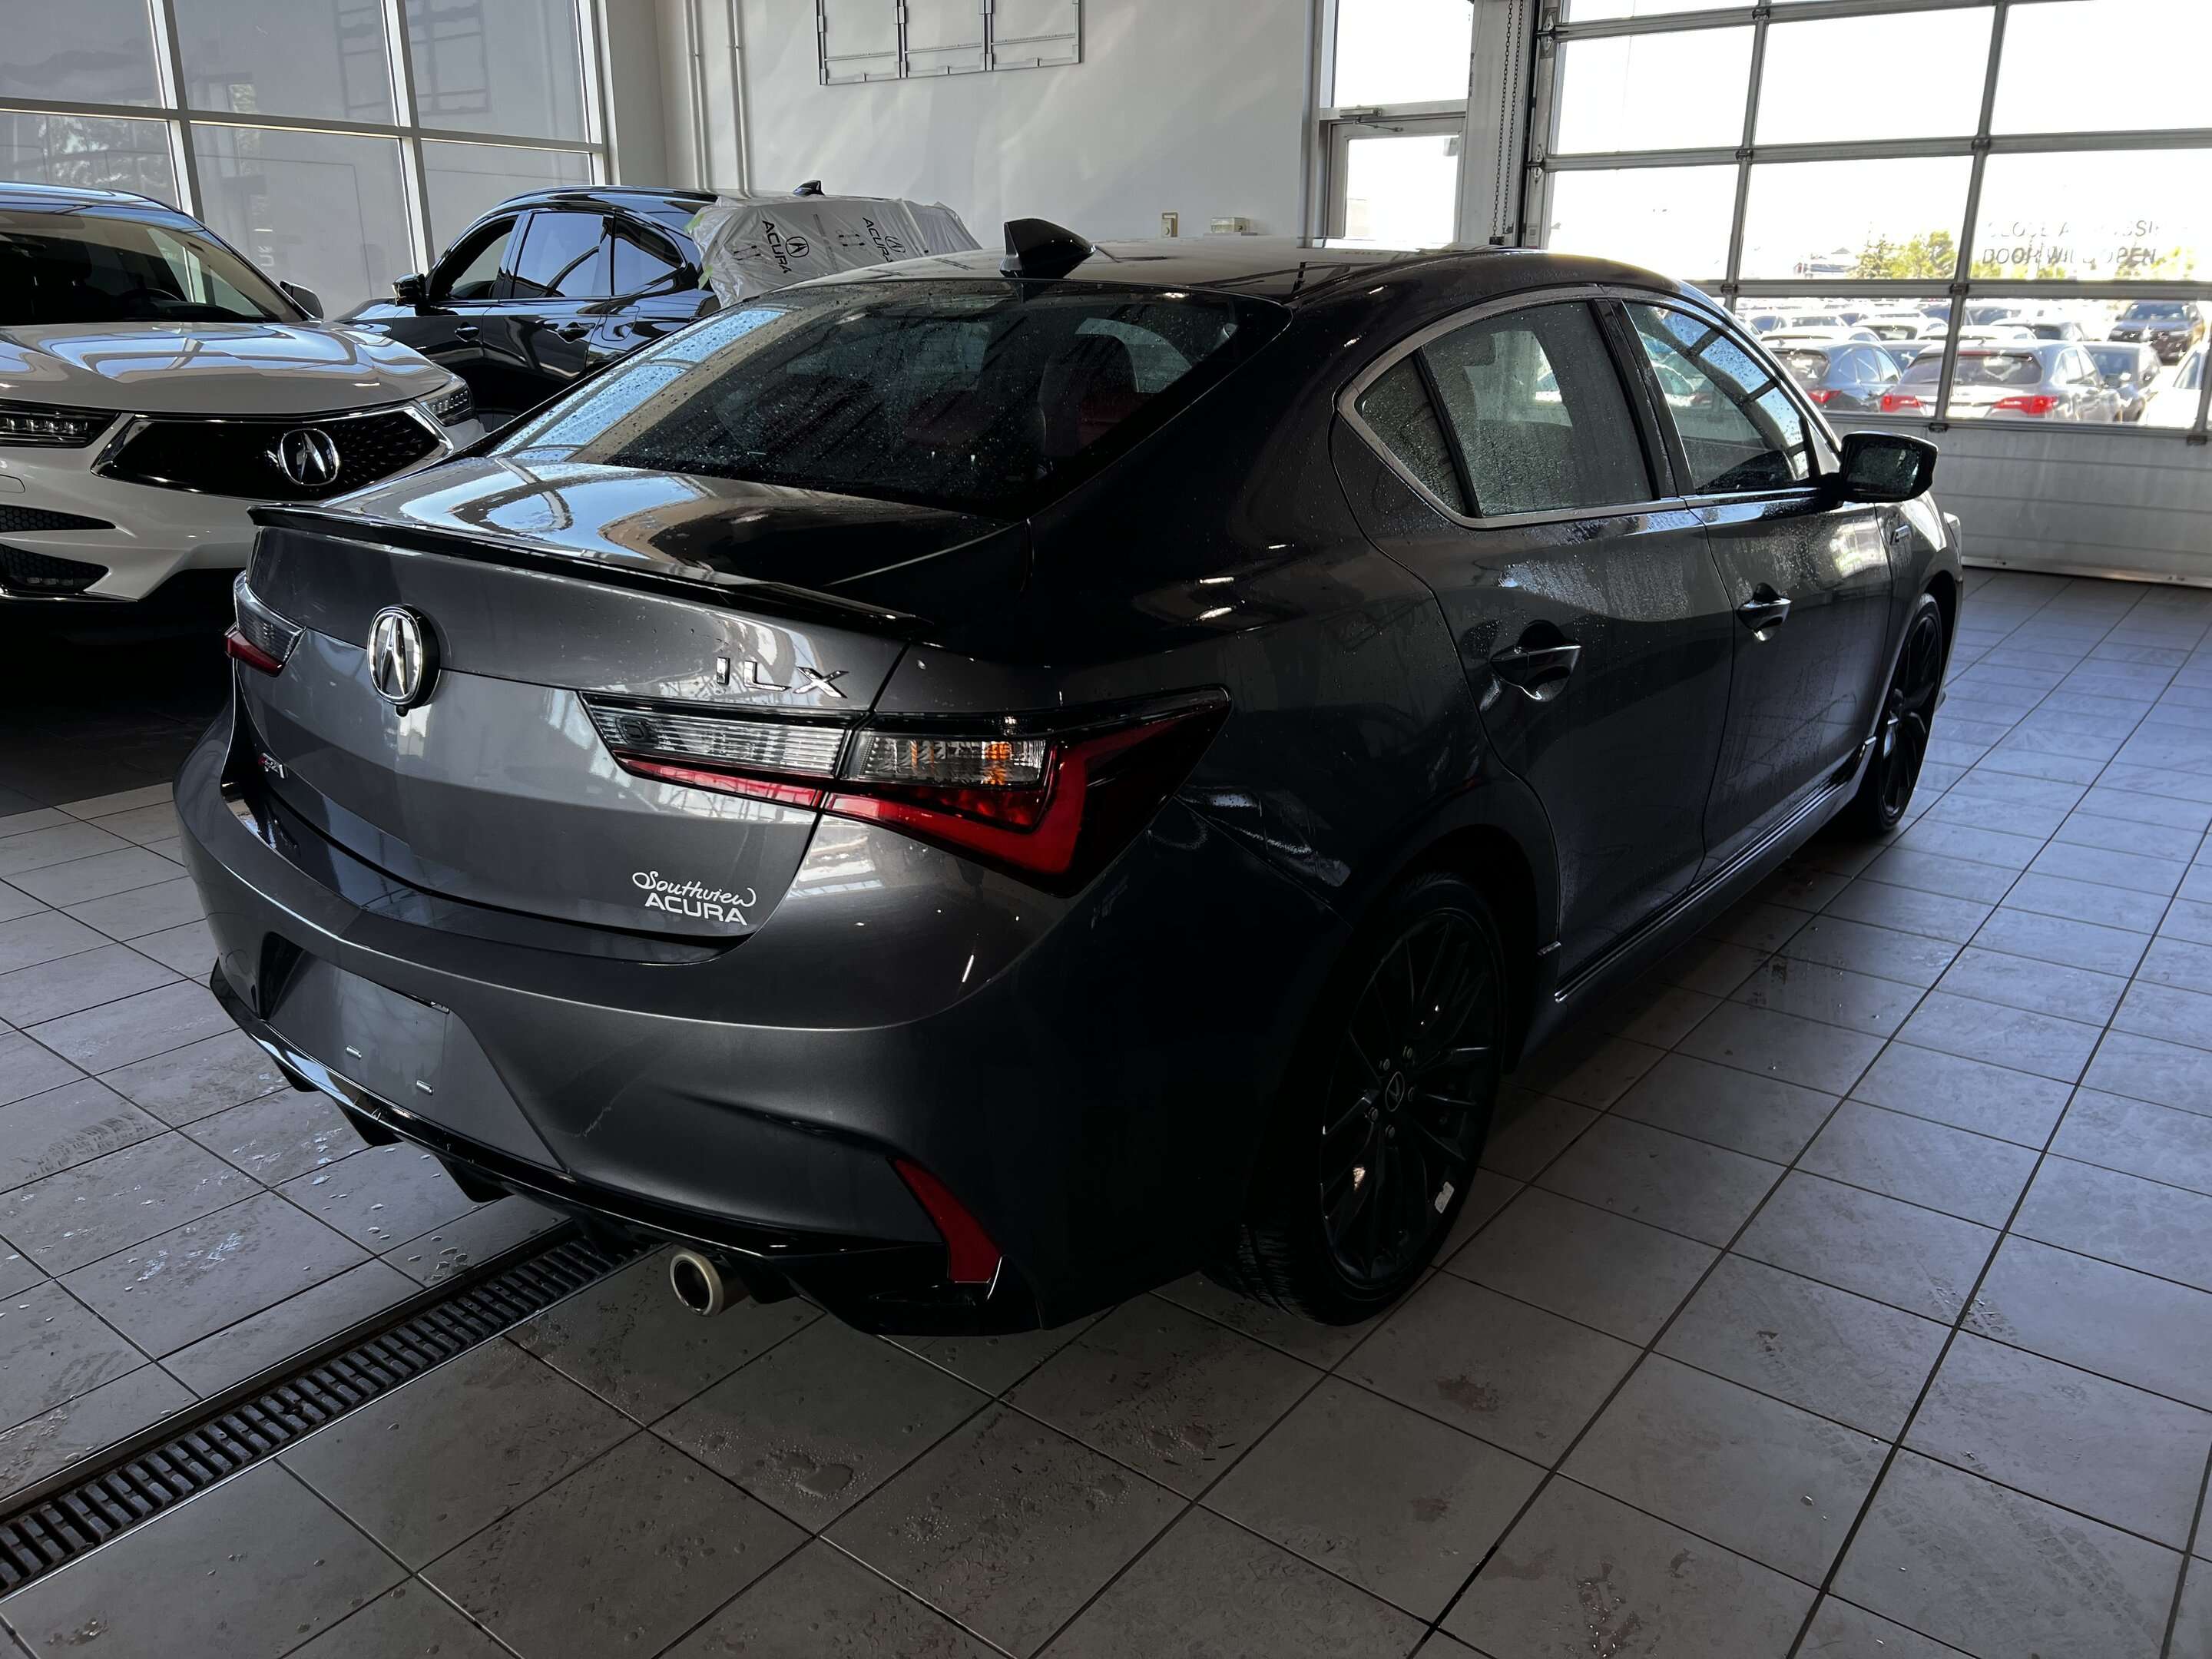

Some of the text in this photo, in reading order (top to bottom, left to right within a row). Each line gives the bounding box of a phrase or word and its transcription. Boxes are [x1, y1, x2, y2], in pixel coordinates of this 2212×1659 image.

[762, 220, 792, 273] ACURA
[716, 657, 849, 698] ILX
[632, 871, 757, 907] Southview
[644, 892, 747, 926] ACURA
